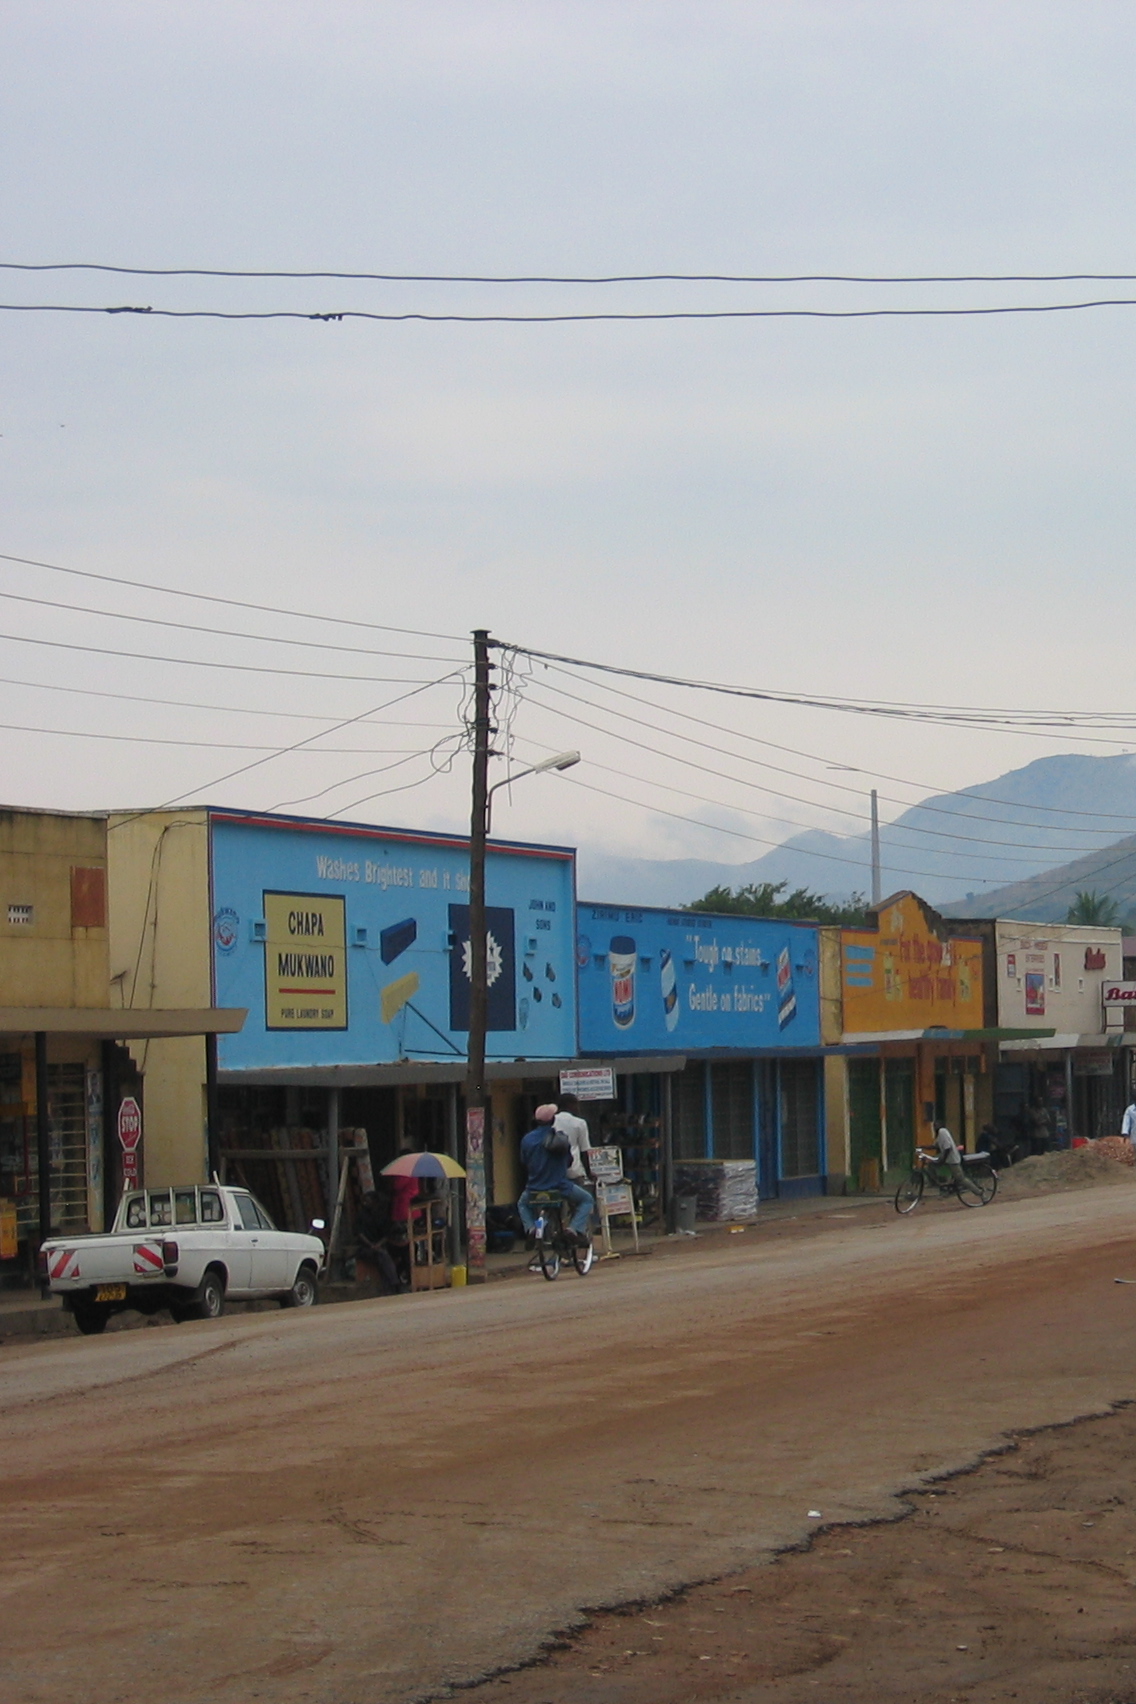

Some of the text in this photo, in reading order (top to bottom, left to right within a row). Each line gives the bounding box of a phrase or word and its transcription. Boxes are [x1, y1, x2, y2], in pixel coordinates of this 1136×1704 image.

[316, 855, 360, 882] Washes
[365, 860, 413, 891] Brightest
[419, 867, 437, 889] and
[443, 868, 450, 890] it
[529, 899, 543, 911] JOHN
[288, 911, 324, 936] CHAPA
[536, 919, 551, 931] SONS
[278, 953, 334, 978] MUKWANO
[689, 983, 718, 1011] Gentle
[721, 993, 731, 1011] on
[281, 1008, 334, 1019] PURE LAUNDRY SOAP
[121, 1115, 138, 1133] STOP
